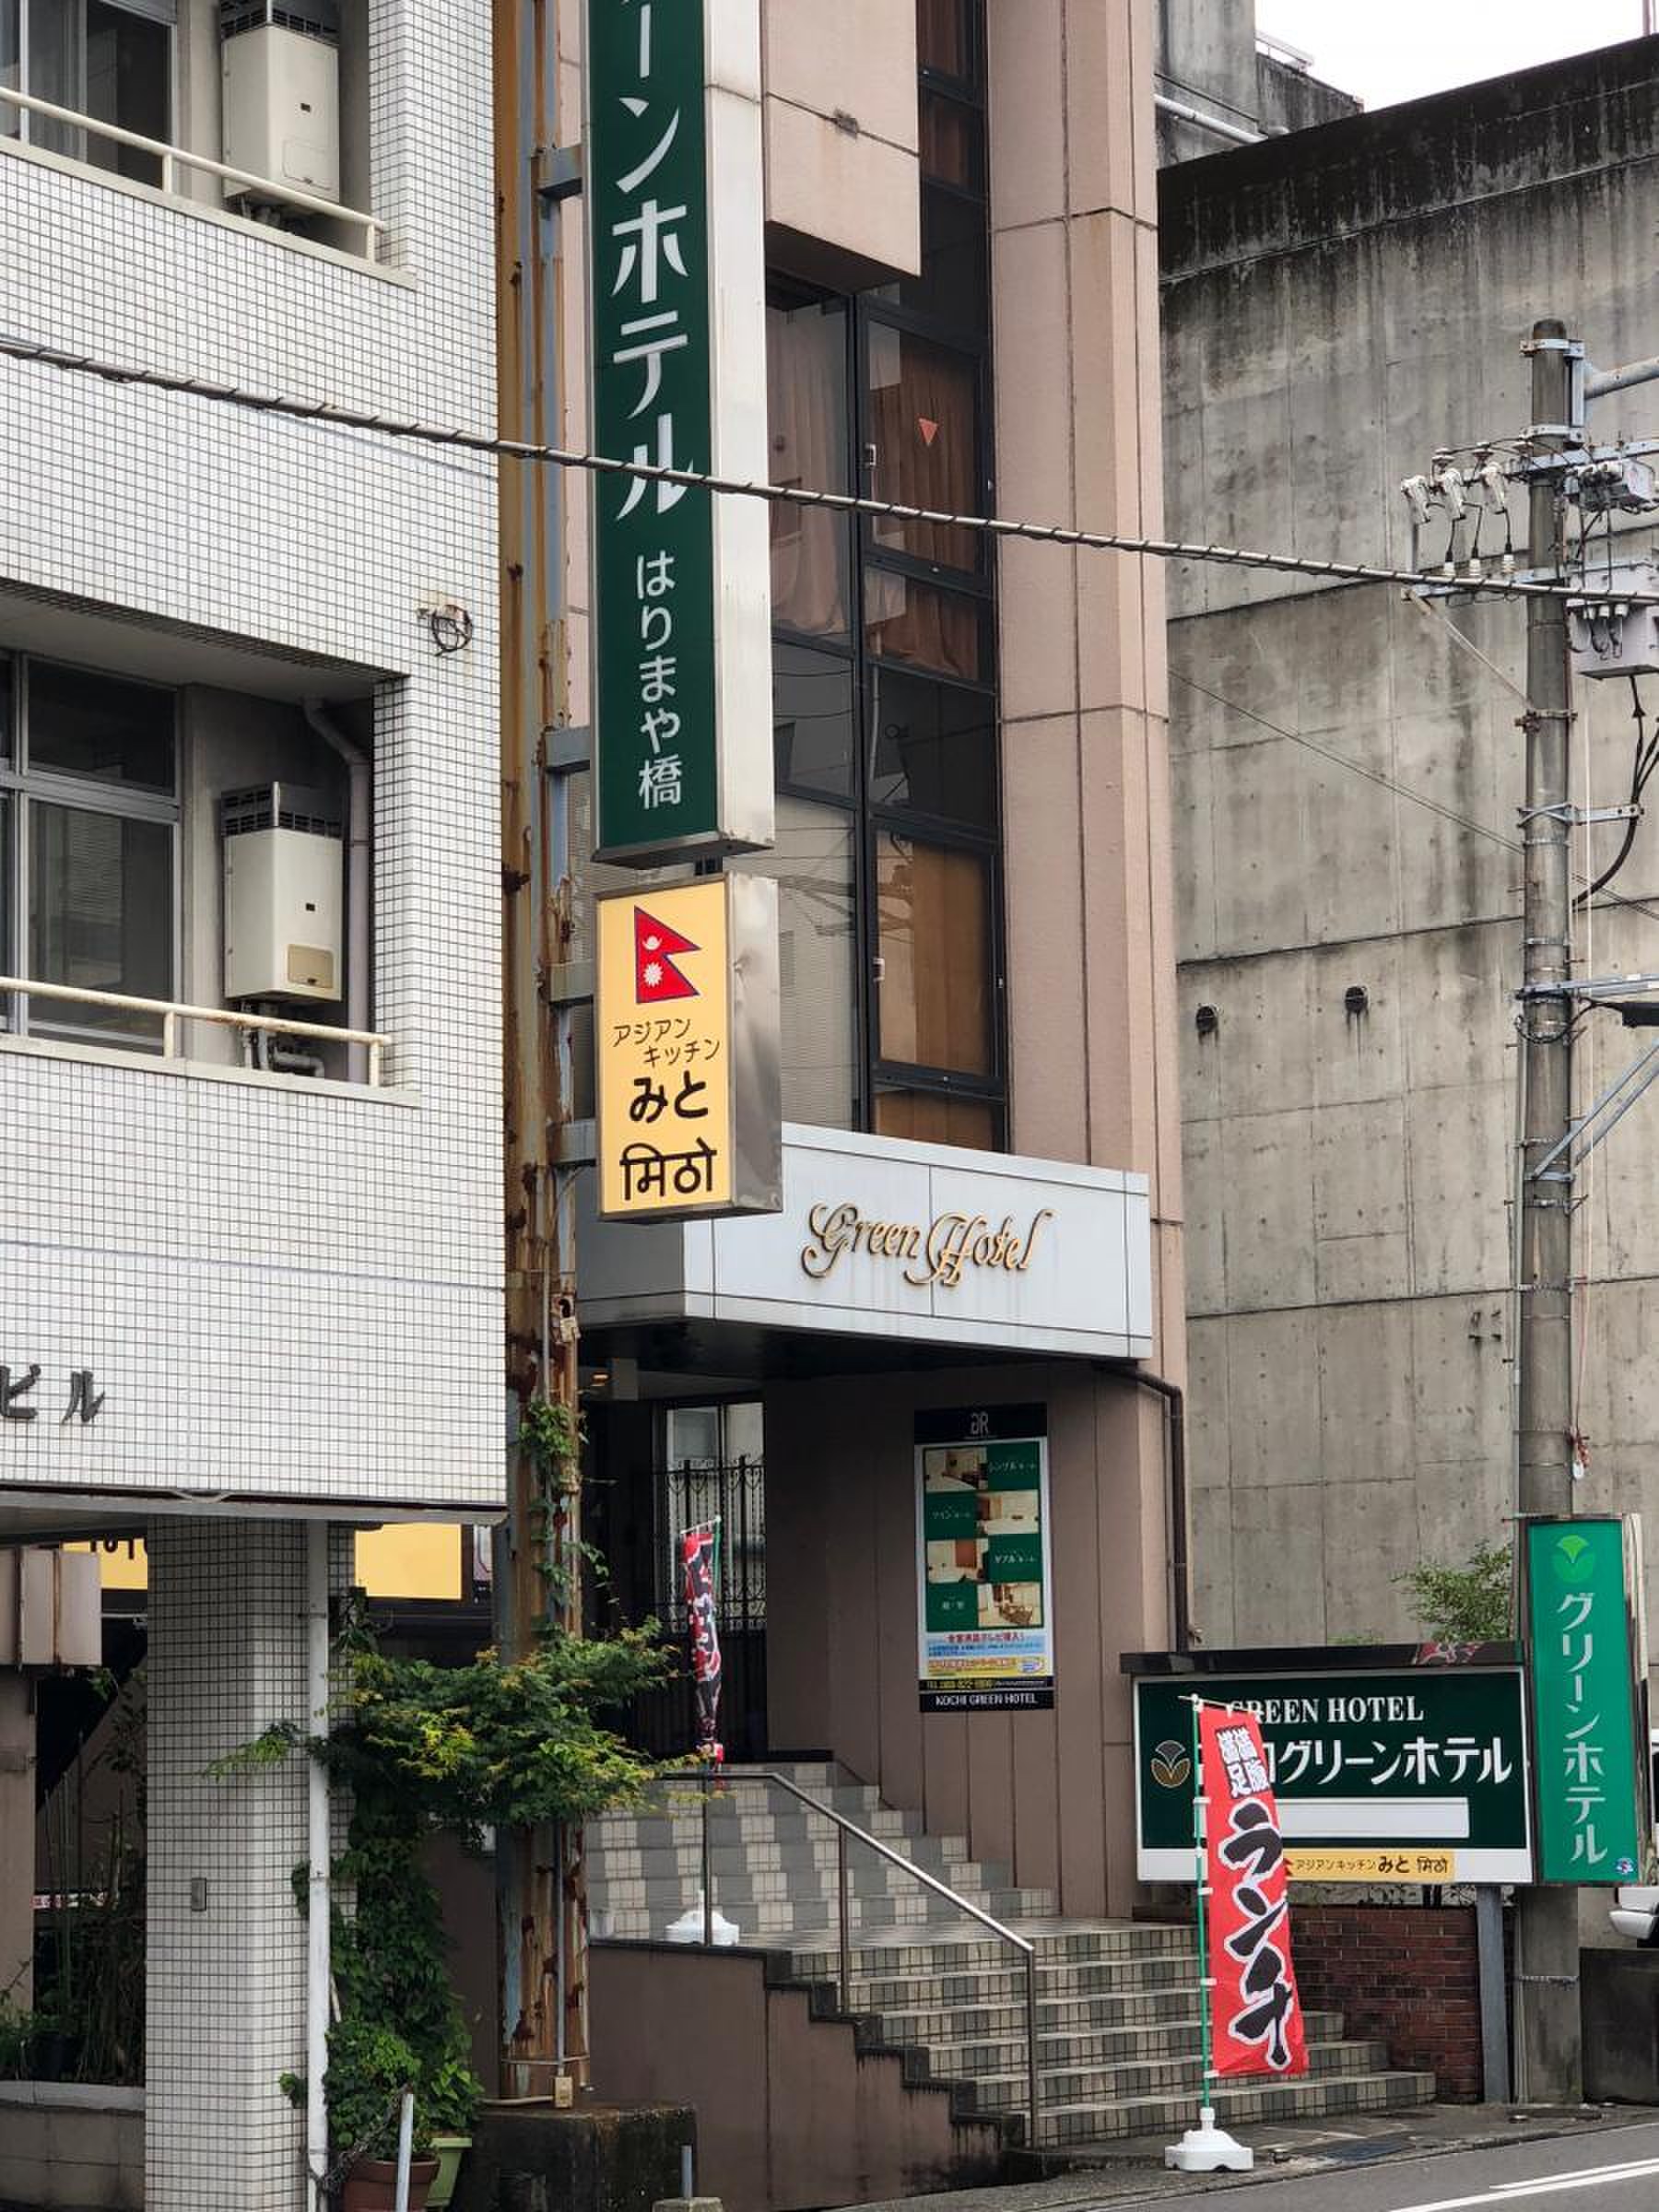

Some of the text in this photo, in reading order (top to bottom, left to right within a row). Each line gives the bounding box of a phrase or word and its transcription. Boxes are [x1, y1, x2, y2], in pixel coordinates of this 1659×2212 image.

[611, 0, 693, 522] ーンホテル
[635, 550, 683, 810] はりまや橋
[612, 1018, 691, 1047] アジアン
[643, 1040, 721, 1067] キッチン
[629, 1070, 709, 1124] みと
[618, 1137, 717, 1200] मिठो
[801, 1202, 1058, 1287] Green Hotel
[1005, 1692, 1037, 1704] HOTEL
[1328, 1696, 1424, 1723] HOTEL
[1556, 1592, 1608, 1865] グリーンホテル
[1197, 1735, 1513, 1785] グリーンホテル
[1377, 1855, 1410, 1874] みと
